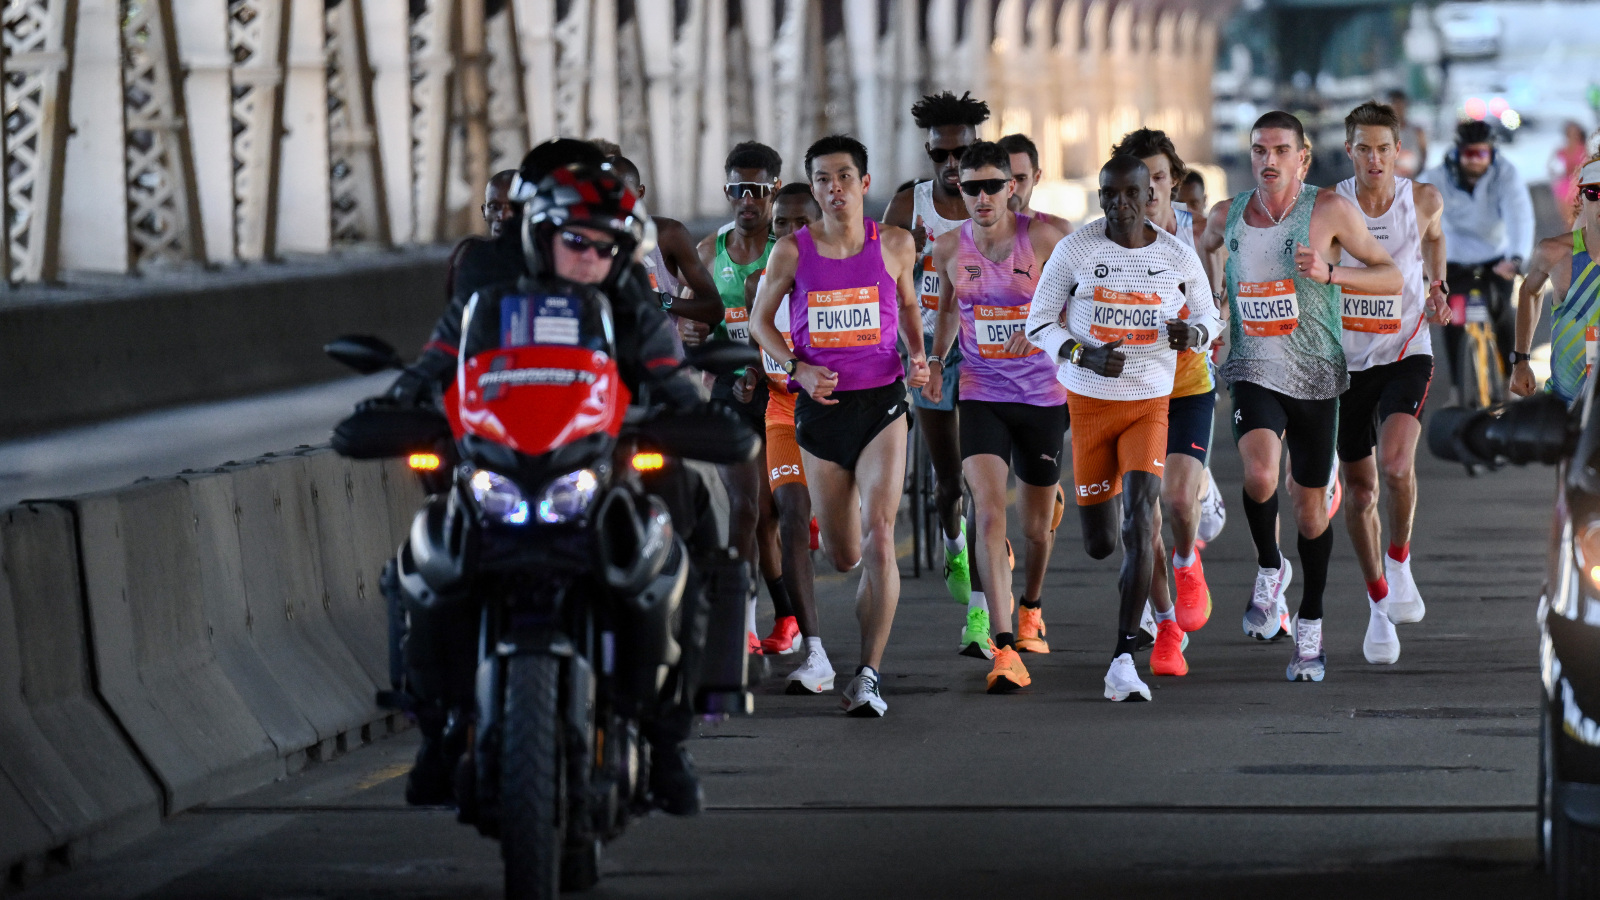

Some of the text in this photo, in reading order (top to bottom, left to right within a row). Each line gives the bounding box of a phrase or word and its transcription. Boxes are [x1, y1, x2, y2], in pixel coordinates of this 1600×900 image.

[1240, 283, 1252, 293] tcs
[816, 293, 831, 303] tcs
[1102, 289, 1118, 300] tcs
[980, 306, 994, 317] tcs
[1240, 299, 1295, 319] KLECKER
[1343, 298, 1394, 317] KYBURZ
[730, 310, 744, 319] tcs
[817, 308, 872, 330] FUKUDA
[1094, 305, 1158, 327] KIPCHOGE
[729, 328, 749, 340] WEL
[765, 354, 786, 372] NA
